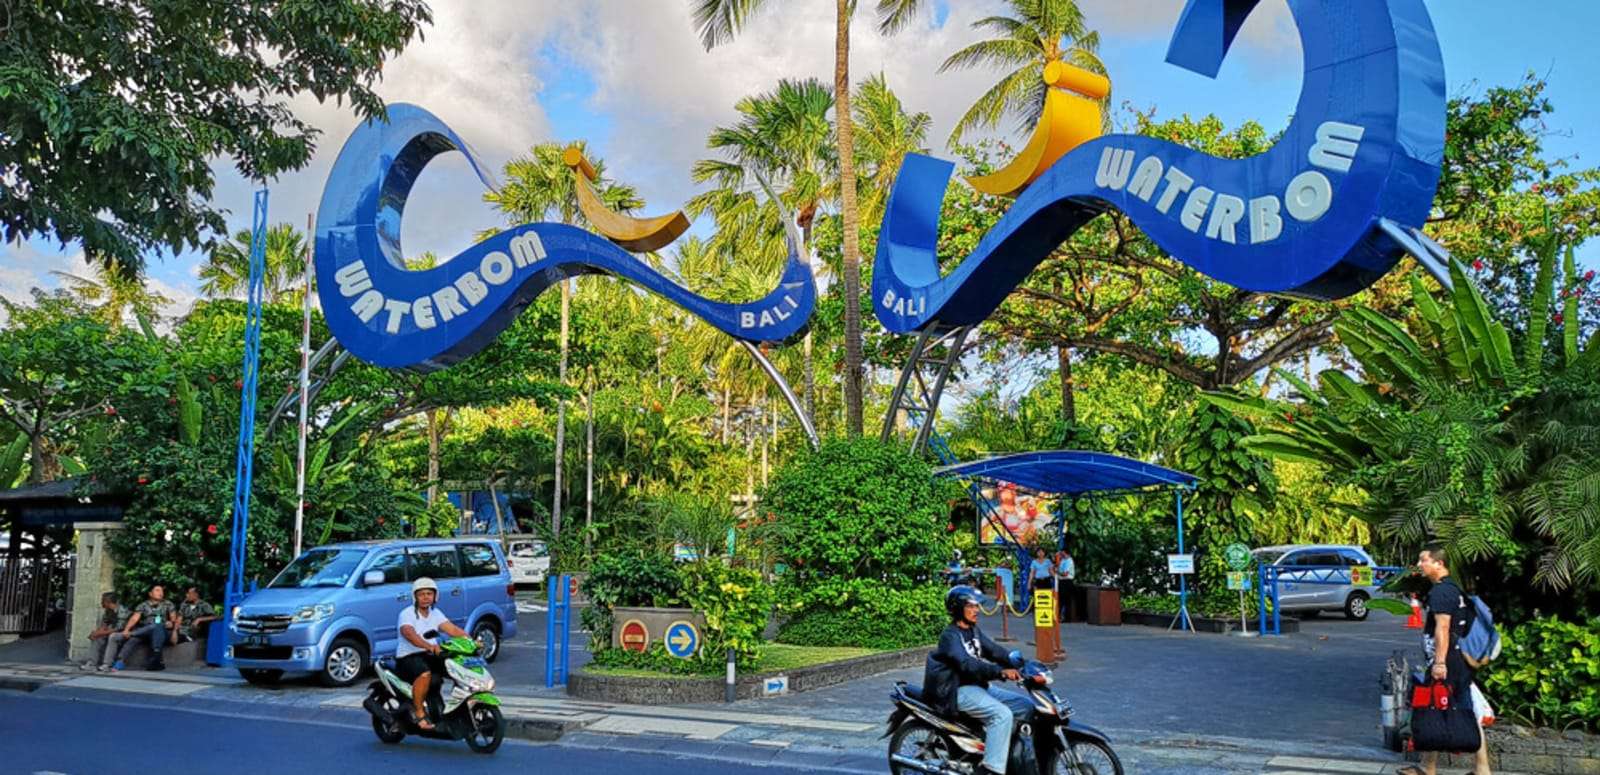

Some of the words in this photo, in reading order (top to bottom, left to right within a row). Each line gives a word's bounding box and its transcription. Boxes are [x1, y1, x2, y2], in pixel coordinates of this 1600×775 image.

[1095, 121, 1365, 244] WATERBOM
[334, 230, 547, 334] WATERBOM
[741, 295, 798, 328] BALI
[883, 289, 925, 316] BALI
